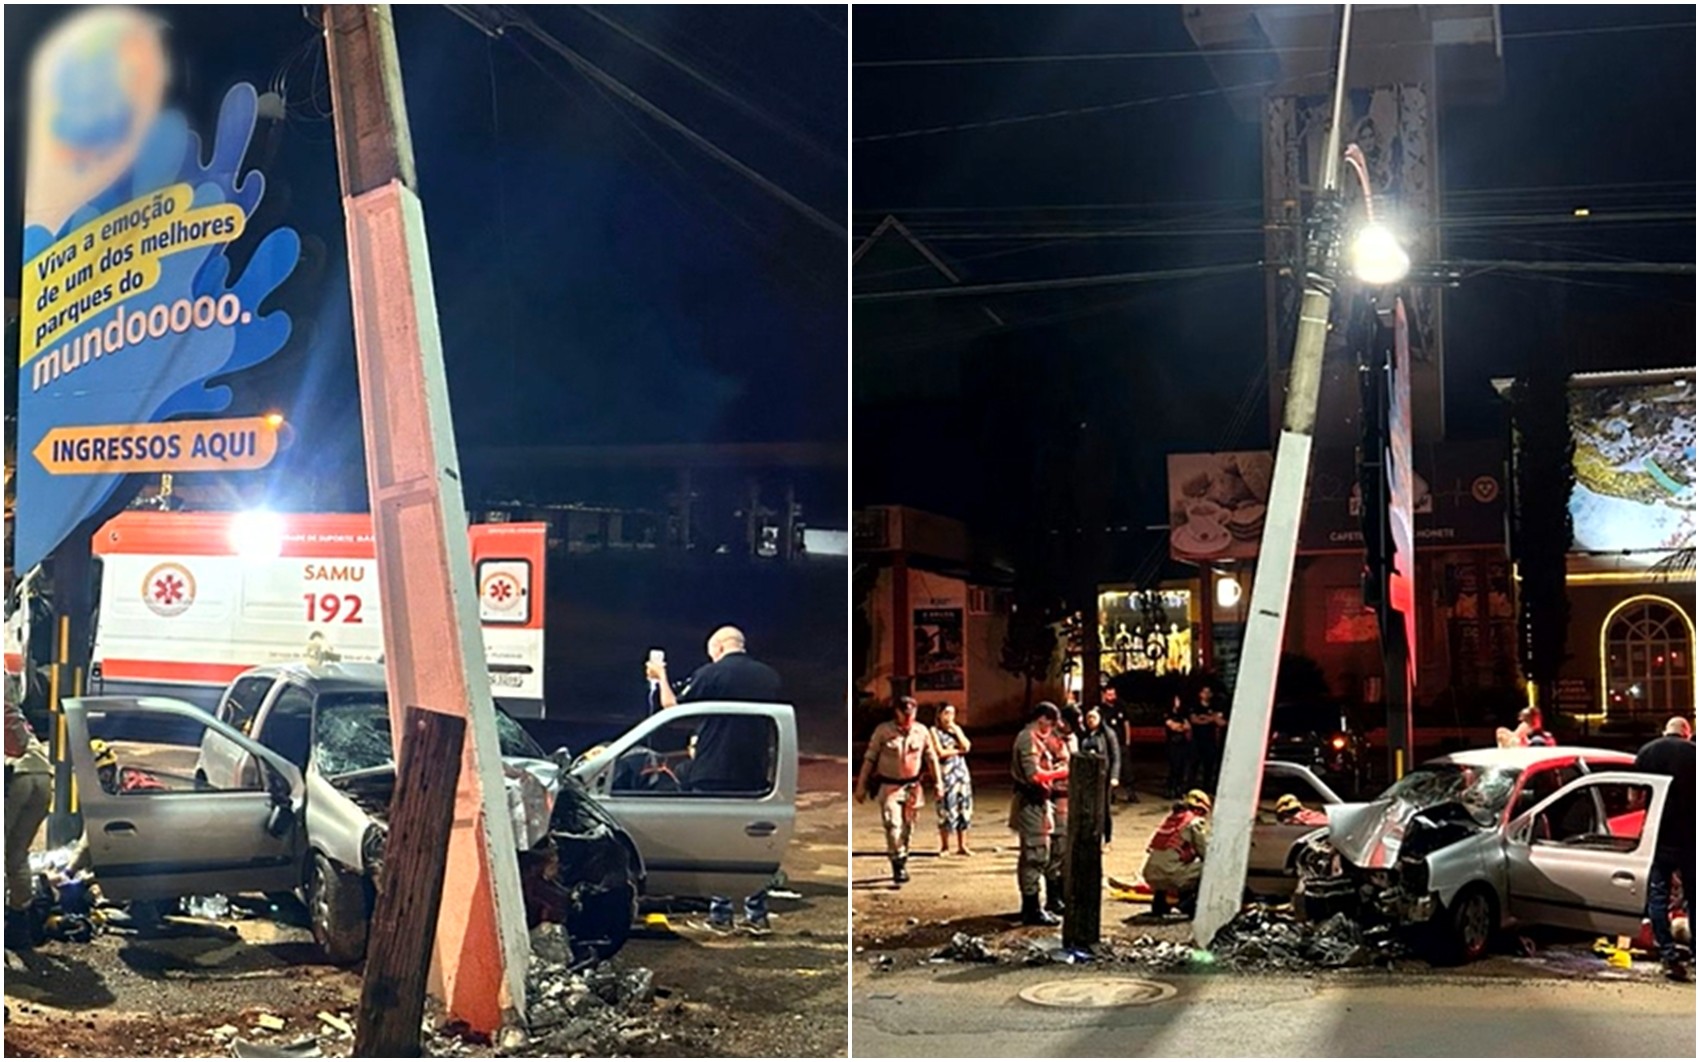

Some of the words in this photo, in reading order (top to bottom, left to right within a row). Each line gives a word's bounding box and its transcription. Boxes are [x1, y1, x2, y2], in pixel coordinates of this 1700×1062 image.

[36, 286, 59, 313] de
[65, 264, 93, 293] um
[100, 242, 134, 274] dos
[141, 215, 236, 256] melhores
[37, 241, 77, 281] Viva
[83, 234, 95, 252] a
[101, 193, 176, 242] emoção
[32, 293, 252, 391] mundooooo.
[35, 283, 113, 348] parques
[119, 270, 144, 295] do
[53, 434, 182, 463] INGRESSOS
[191, 430, 256, 462] AQUI
[303, 592, 363, 623] 192
[304, 564, 365, 582] SAMU
